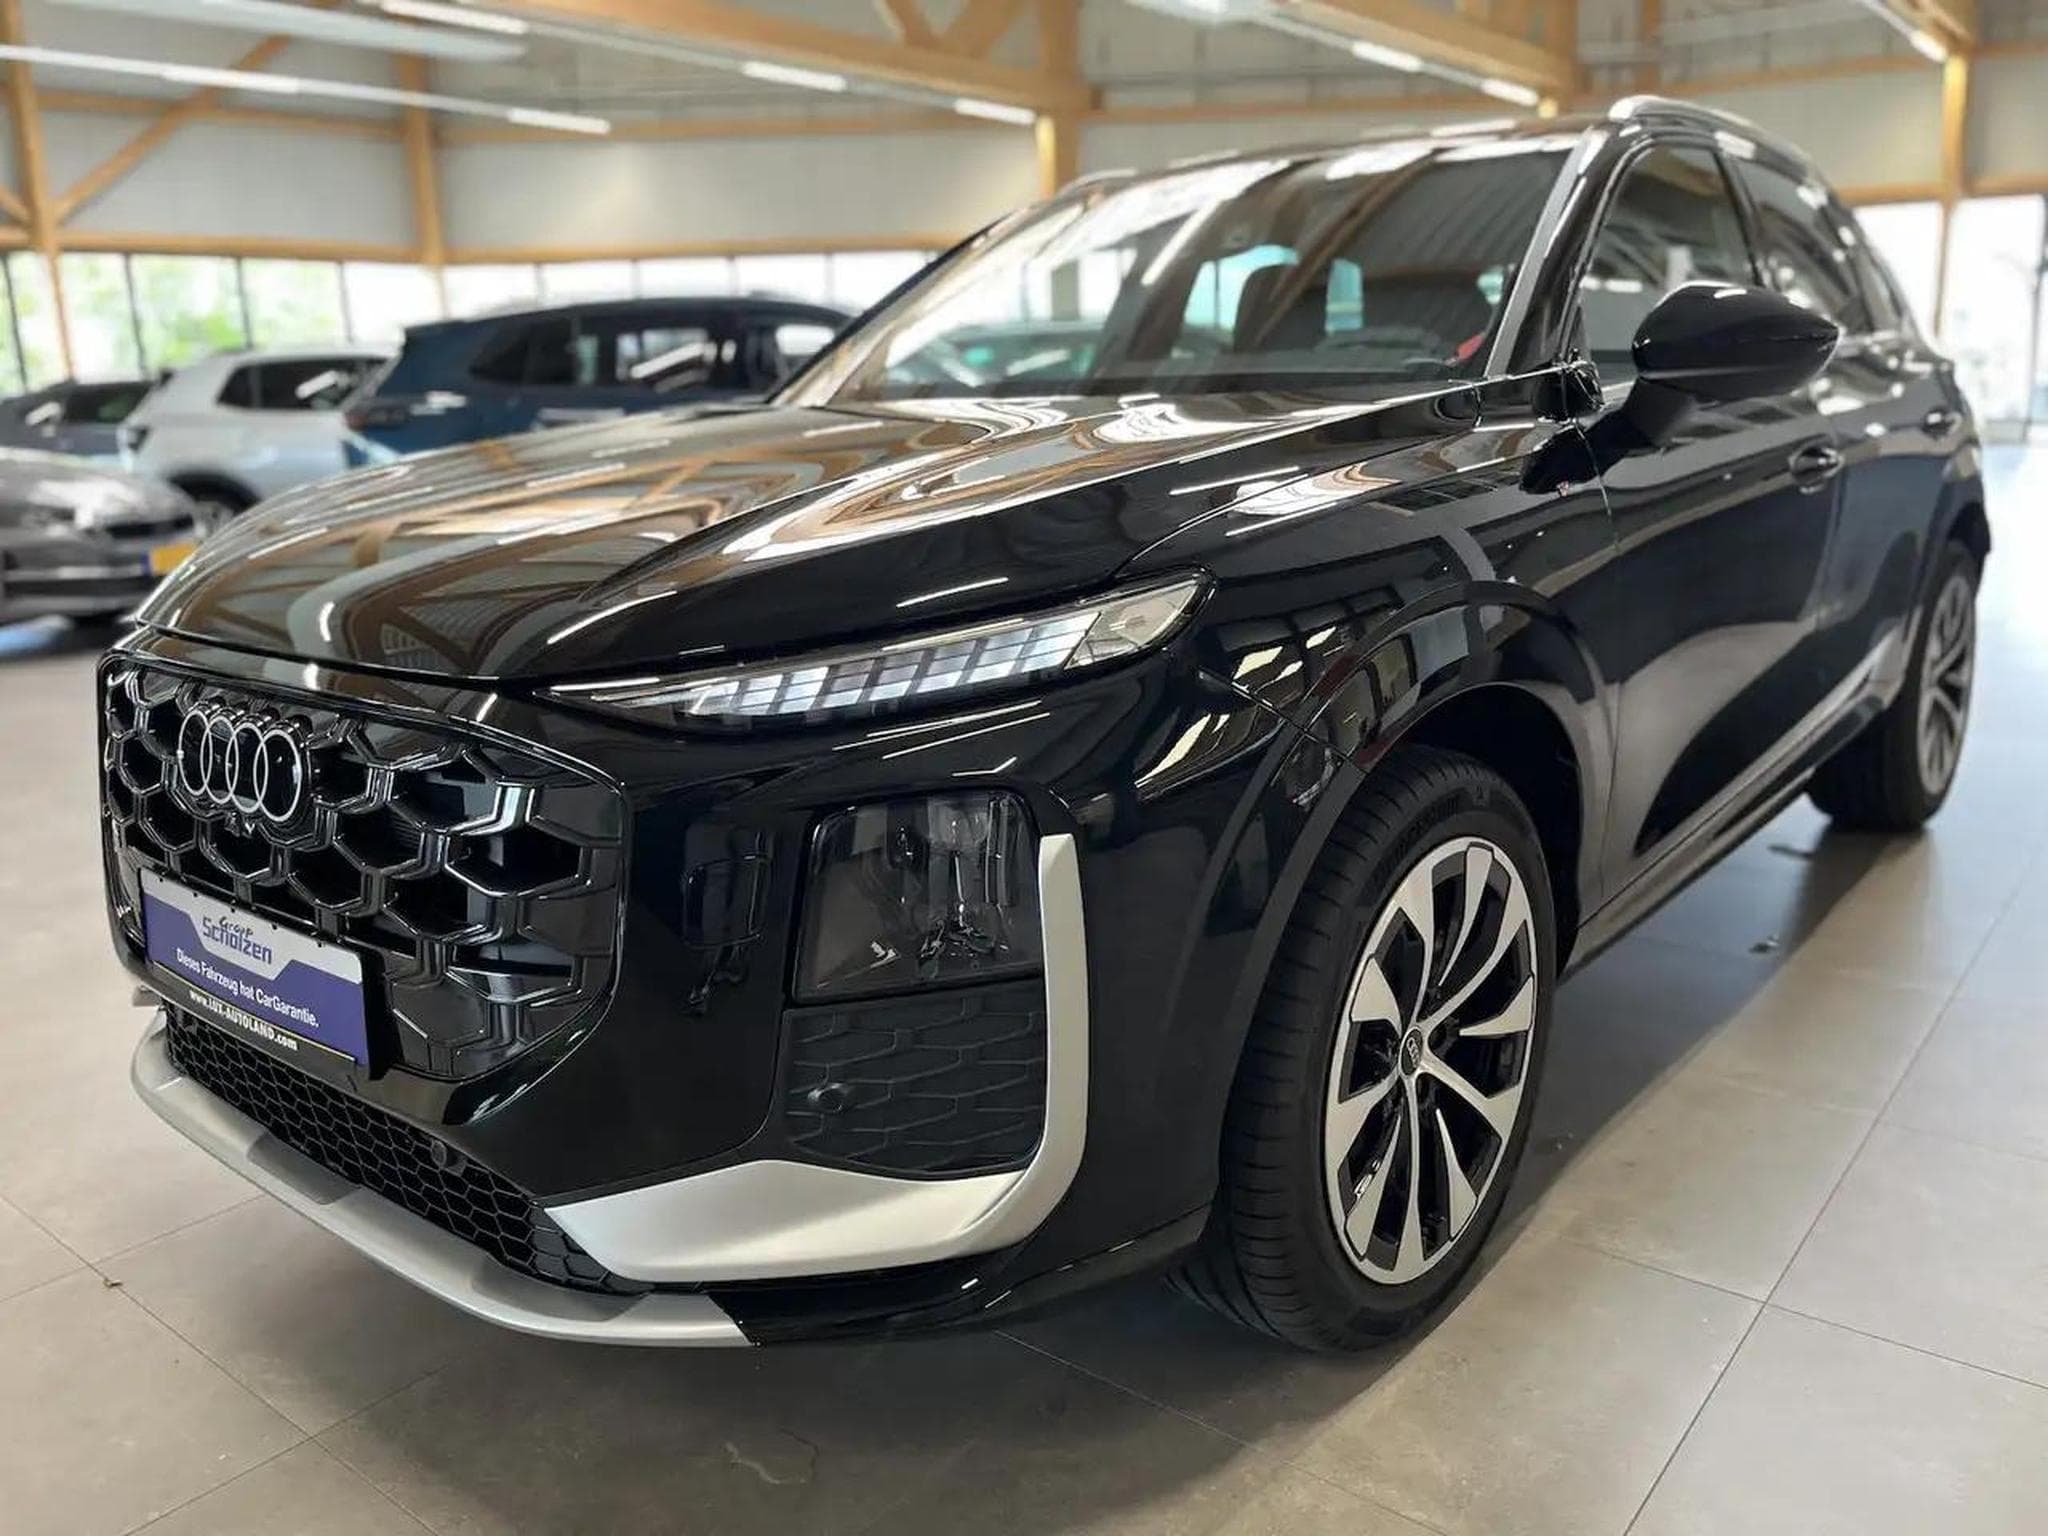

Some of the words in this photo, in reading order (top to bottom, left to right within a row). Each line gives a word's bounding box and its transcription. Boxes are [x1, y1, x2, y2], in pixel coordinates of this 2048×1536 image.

[203, 916, 272, 965] Scholzen
[176, 947, 201, 974] Dieses
[201, 960, 239, 996] Fahrzeug
[239, 980, 255, 1001] hat
[255, 988, 320, 1028] CarGarantie.
